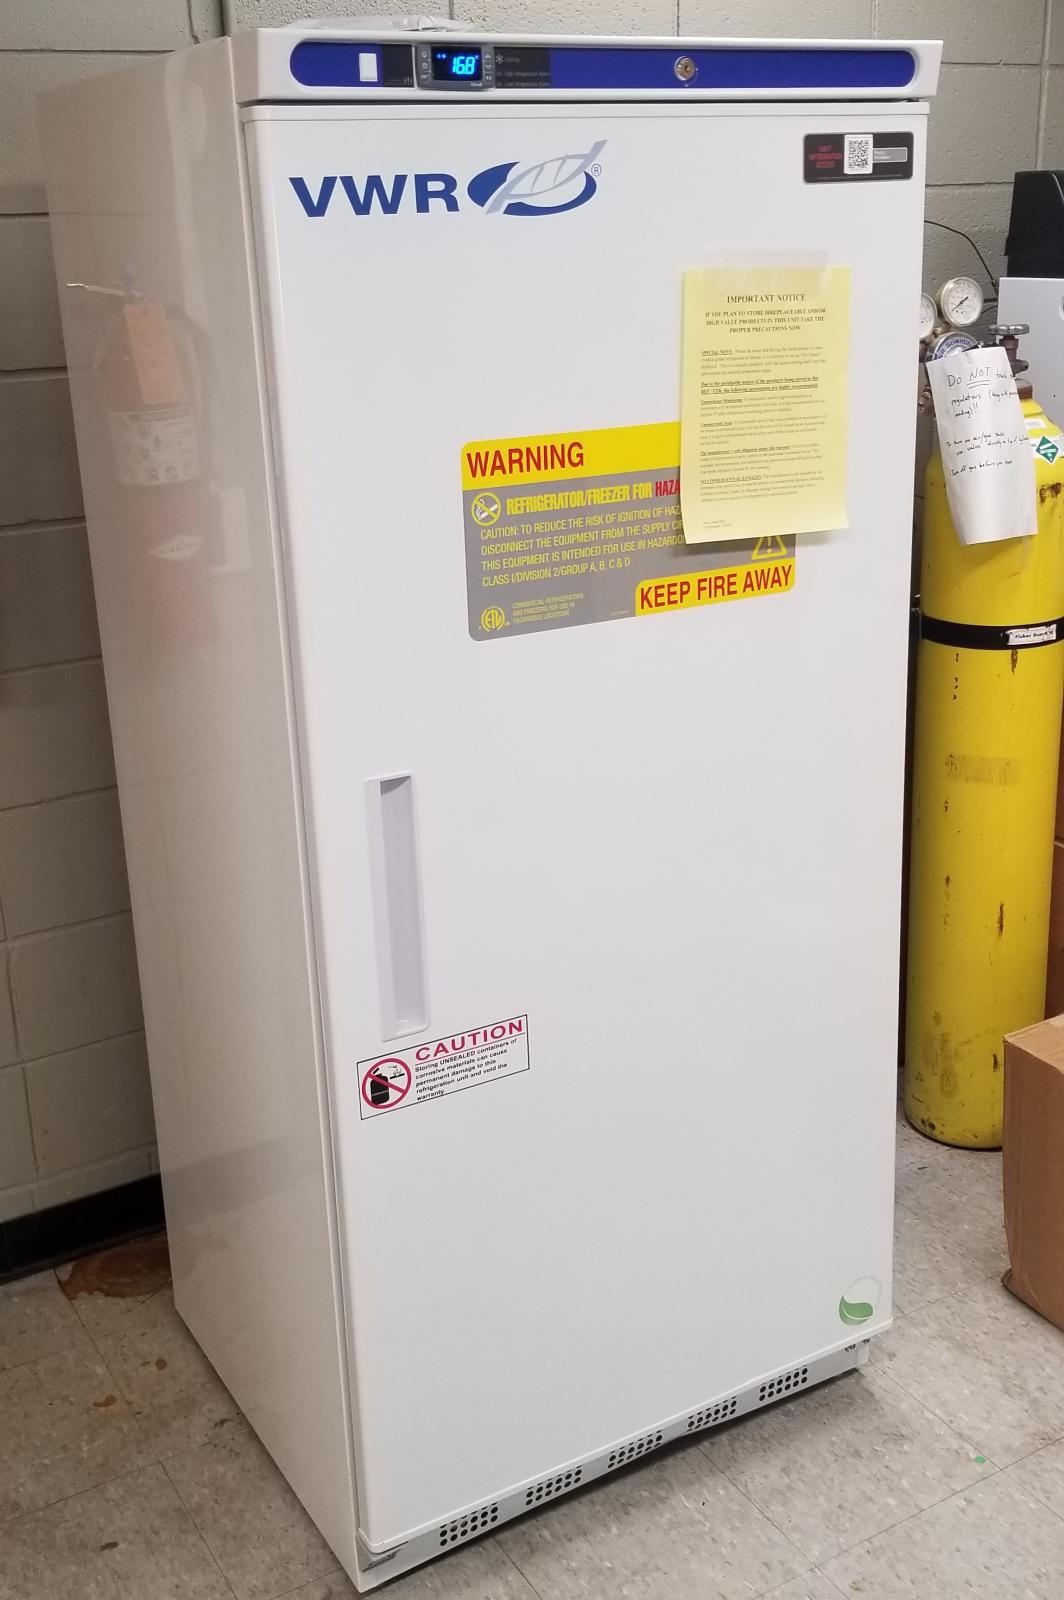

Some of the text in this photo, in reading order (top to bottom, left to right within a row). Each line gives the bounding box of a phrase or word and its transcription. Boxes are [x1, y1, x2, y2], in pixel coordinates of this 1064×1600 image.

[288, 173, 460, 218] VWR
[727, 294, 806, 304] IMPORTANT NOTICE
[948, 374, 962, 387] Do
[969, 367, 990, 382] NOT
[467, 441, 584, 478] WARNING
[506, 486, 630, 516] REFRIGERATOR/FREEZER
[633, 482, 652, 498] FOR
[480, 526, 518, 540] CAUTION:
[520, 524, 532, 536] TO
[534, 518, 567, 534] REDUCE
[568, 518, 584, 530] THE
[586, 515, 604, 528] RISK
[606, 514, 616, 526] OF
[618, 508, 652, 524] IGNITION
[653, 506, 663, 518] OF
[481, 540, 533, 556] DISCONNECT
[536, 536, 552, 548] THE
[554, 530, 600, 546] EQUIPMENT
[602, 526, 624, 540] FROM
[626, 524, 641, 537] THE
[642, 521, 670, 534] SUPPLY
[482, 559, 500, 572] THIS
[503, 552, 550, 568] EQUIPMENT
[552, 550, 560, 562] IS
[562, 544, 602, 562] INTENDED
[603, 542, 618, 555] FOR
[620, 540, 636, 552] USE
[638, 538, 646, 550] IN
[482, 574, 510, 587] CLASS
[616, 558, 623, 569] &
[624, 557, 631, 568] D
[640, 564, 792, 610] KEEP FIRE AWAY
[415, 1020, 523, 1061] CAUTION
[415, 1061, 439, 1073] Storing
[440, 1050, 476, 1065] UNSEALED
[477, 1040, 510, 1054] containers
[415, 1048, 508, 1080] corrosive materials can cause
[416, 1074, 450, 1088] permanent
[451, 1065, 476, 1078] damage
[485, 1058, 497, 1068] this
[416, 1062, 508, 1094] refrigeration unit and void the
[416, 1088, 446, 1101] warranty.
